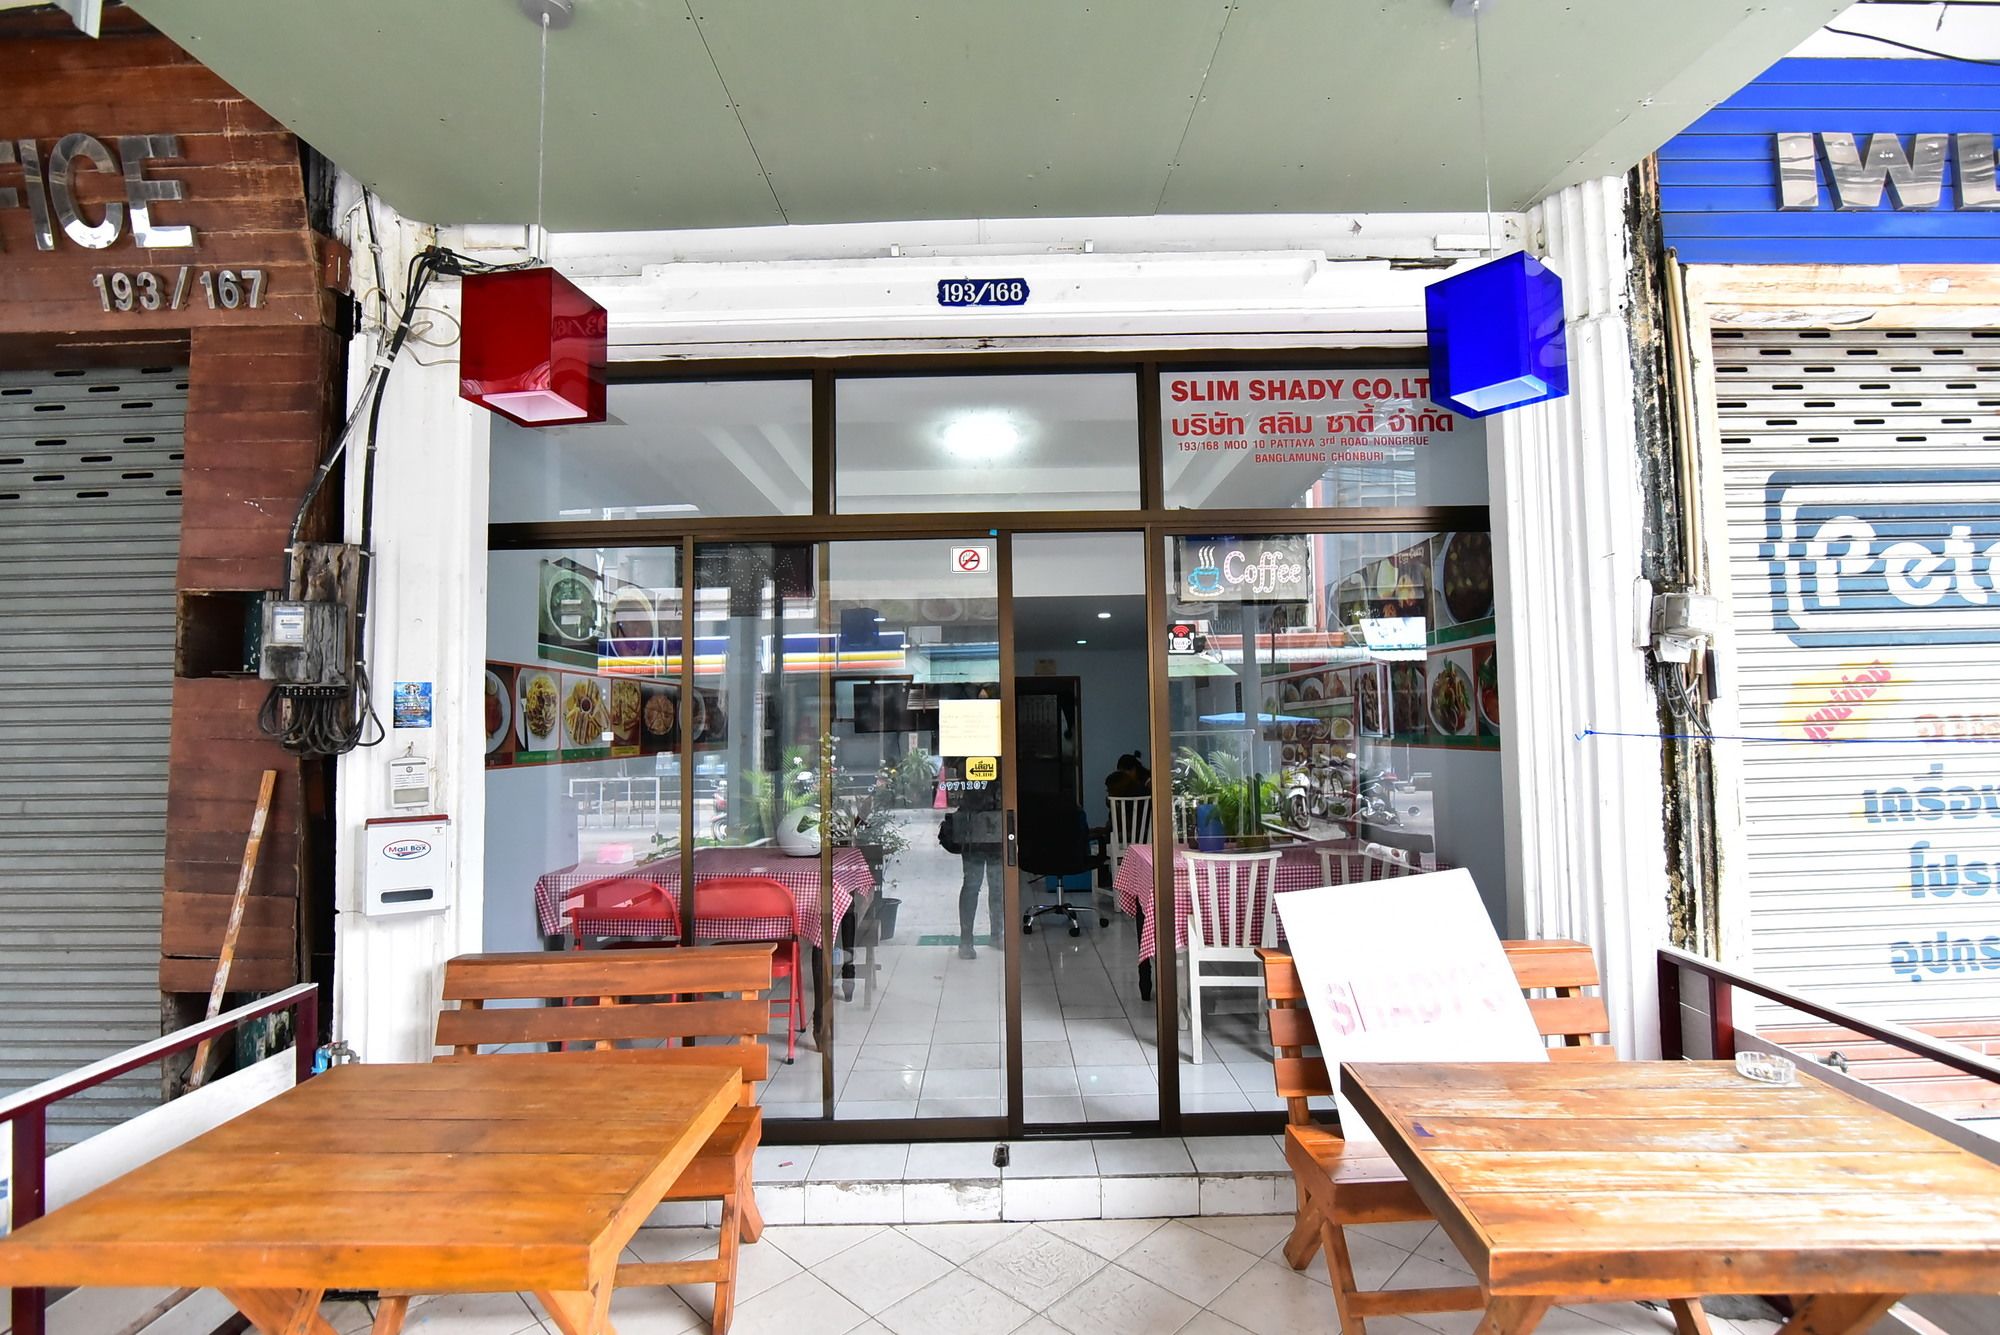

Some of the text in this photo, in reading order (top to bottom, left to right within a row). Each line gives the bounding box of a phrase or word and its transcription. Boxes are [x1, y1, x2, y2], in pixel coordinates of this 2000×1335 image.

[93, 266, 264, 312] 193/167
[942, 281, 1023, 304] 193/168
[1171, 377, 1430, 401] SLIM SHADY CO.LT
[1172, 411, 1244, 436] บริษัท
[1259, 411, 1312, 434] สลิม
[1387, 407, 1453, 432] จำกัด
[1178, 435, 1429, 452] 193/168 MOO 10 PATTAYA 3rd ROAD NONGPRUE
[1255, 451, 1384, 463] BANGLAMUNG CHONBURI
[1223, 550, 1302, 593] Coffee
[1805, 515, 2000, 607] Pet
[388, 844, 427, 853] Mail Box
[1910, 840, 2000, 899] โปร
